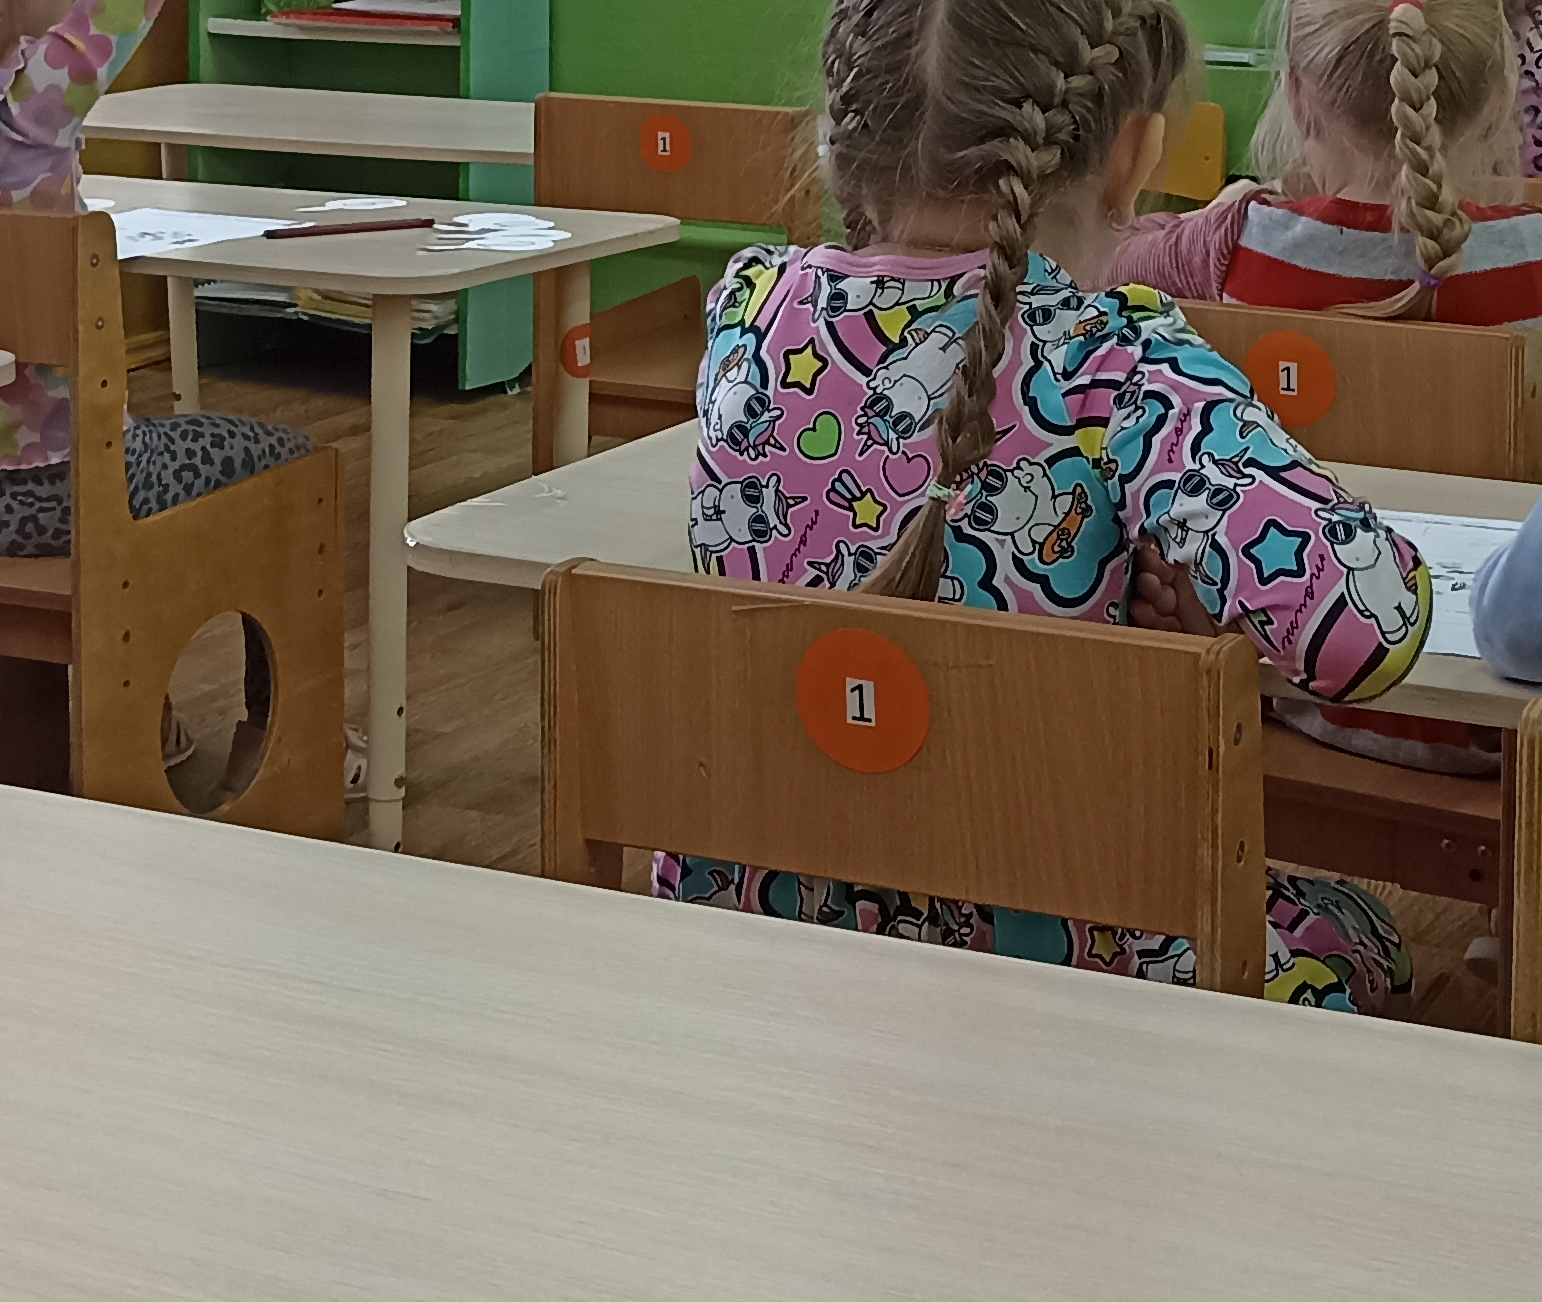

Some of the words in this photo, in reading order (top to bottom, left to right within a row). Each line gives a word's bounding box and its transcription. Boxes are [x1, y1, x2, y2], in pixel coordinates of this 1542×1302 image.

[659, 136, 670, 153] 1
[1280, 365, 1296, 393] 1
[850, 683, 873, 723] 1
